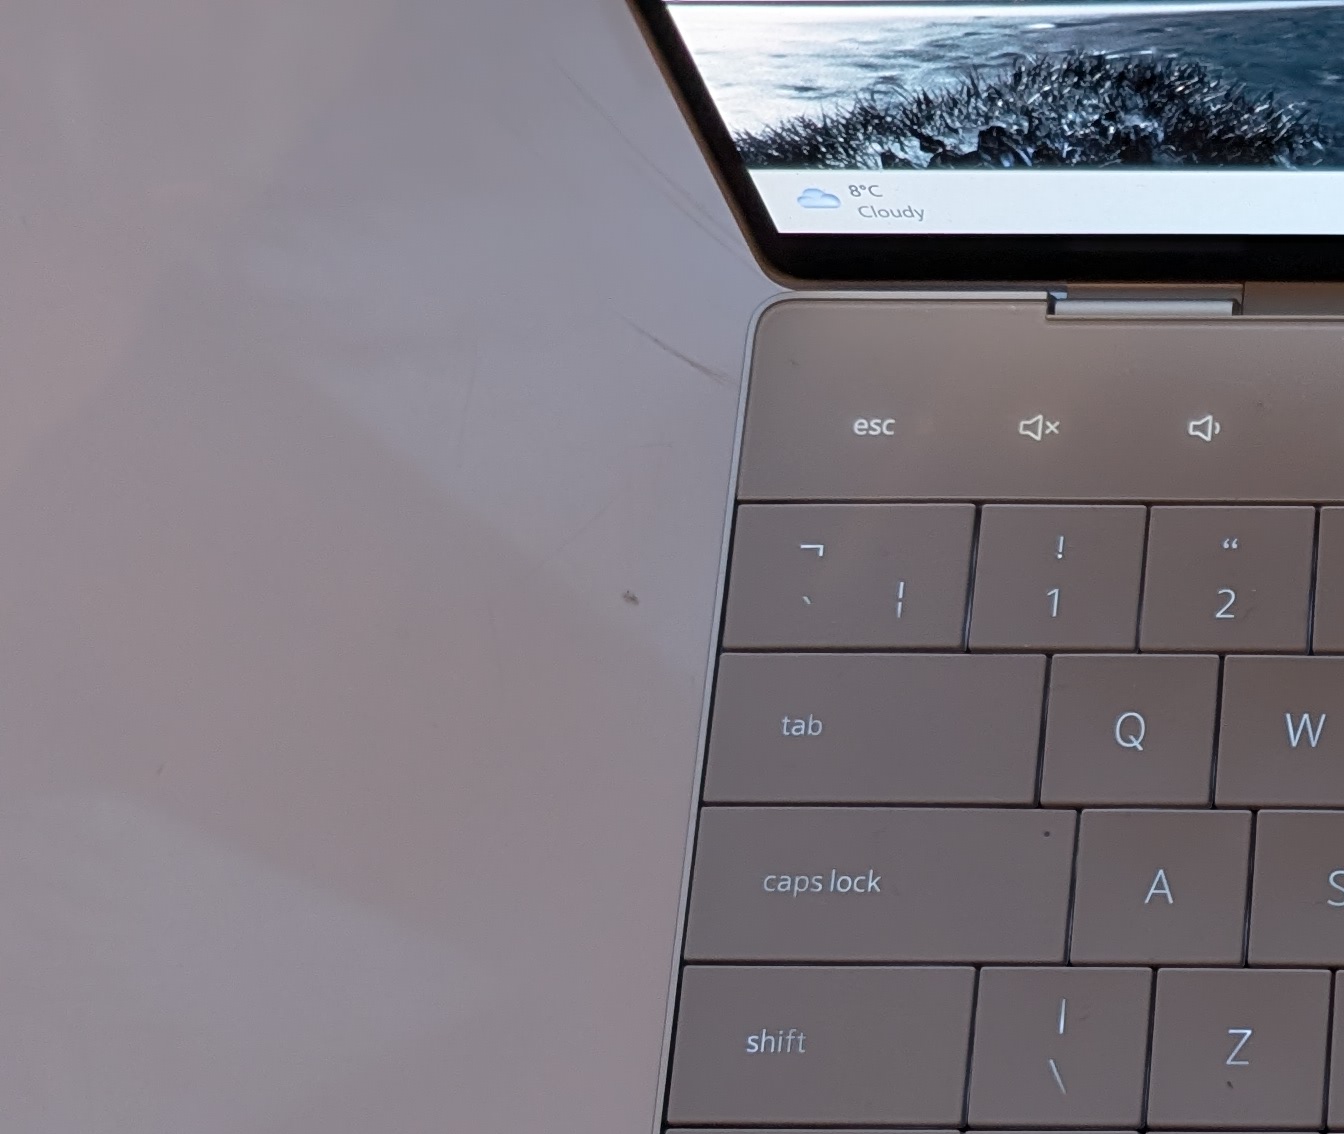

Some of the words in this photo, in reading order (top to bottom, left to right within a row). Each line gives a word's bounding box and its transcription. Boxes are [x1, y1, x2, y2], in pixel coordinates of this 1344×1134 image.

[848, 184, 883, 198] 8°C
[857, 204, 925, 222] Cloudy
[853, 418, 896, 436] esc
[1047, 588, 1060, 618] 1
[1215, 588, 1236, 619] 2
[781, 713, 823, 736] tab
[1115, 711, 1146, 751] Q
[1285, 713, 1326, 748] W
[763, 875, 823, 898] caps
[829, 868, 882, 893] lock
[1144, 868, 1174, 904] A
[746, 1028, 806, 1053] shift
[1226, 1029, 1252, 1065] Z
